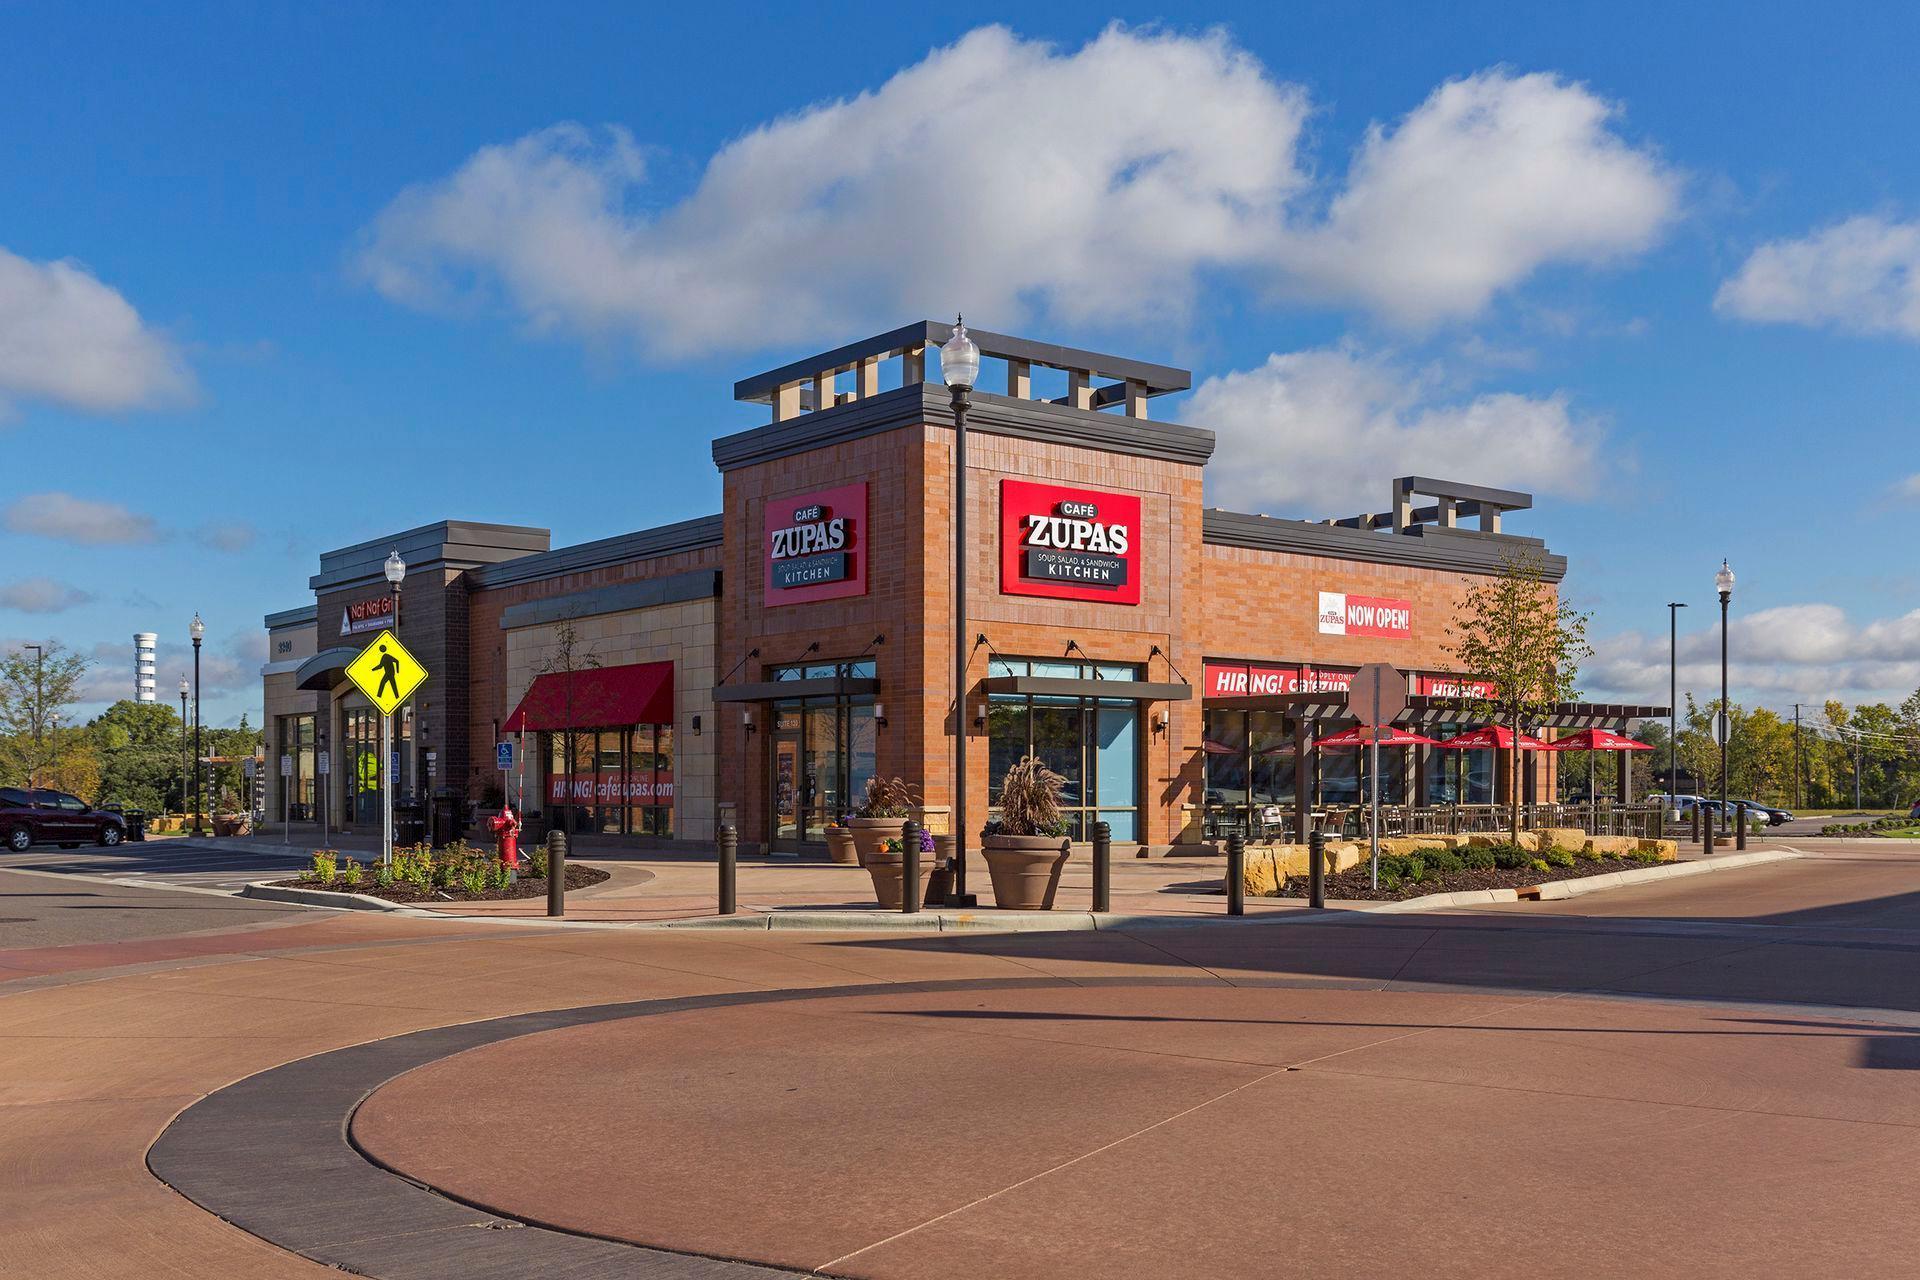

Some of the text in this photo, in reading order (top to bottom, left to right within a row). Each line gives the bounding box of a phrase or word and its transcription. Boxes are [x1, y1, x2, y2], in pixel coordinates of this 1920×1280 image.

[796, 506, 818, 521] CAFÉ
[1063, 503, 1094, 517] CAFÉ
[772, 518, 844, 559] ZUPAS
[1029, 515, 1128, 555] ZUPAS
[1048, 563, 1110, 580] KITCHEN
[1086, 558, 1120, 569] SANDWICH
[785, 566, 830, 583] KITCHEN
[351, 601, 365, 619] Naf
[366, 598, 380, 616] Naf
[1319, 614, 1344, 625] ZUPAS
[1347, 605, 1410, 630] NOW OPEN!
[1216, 671, 1284, 694] HIRING!
